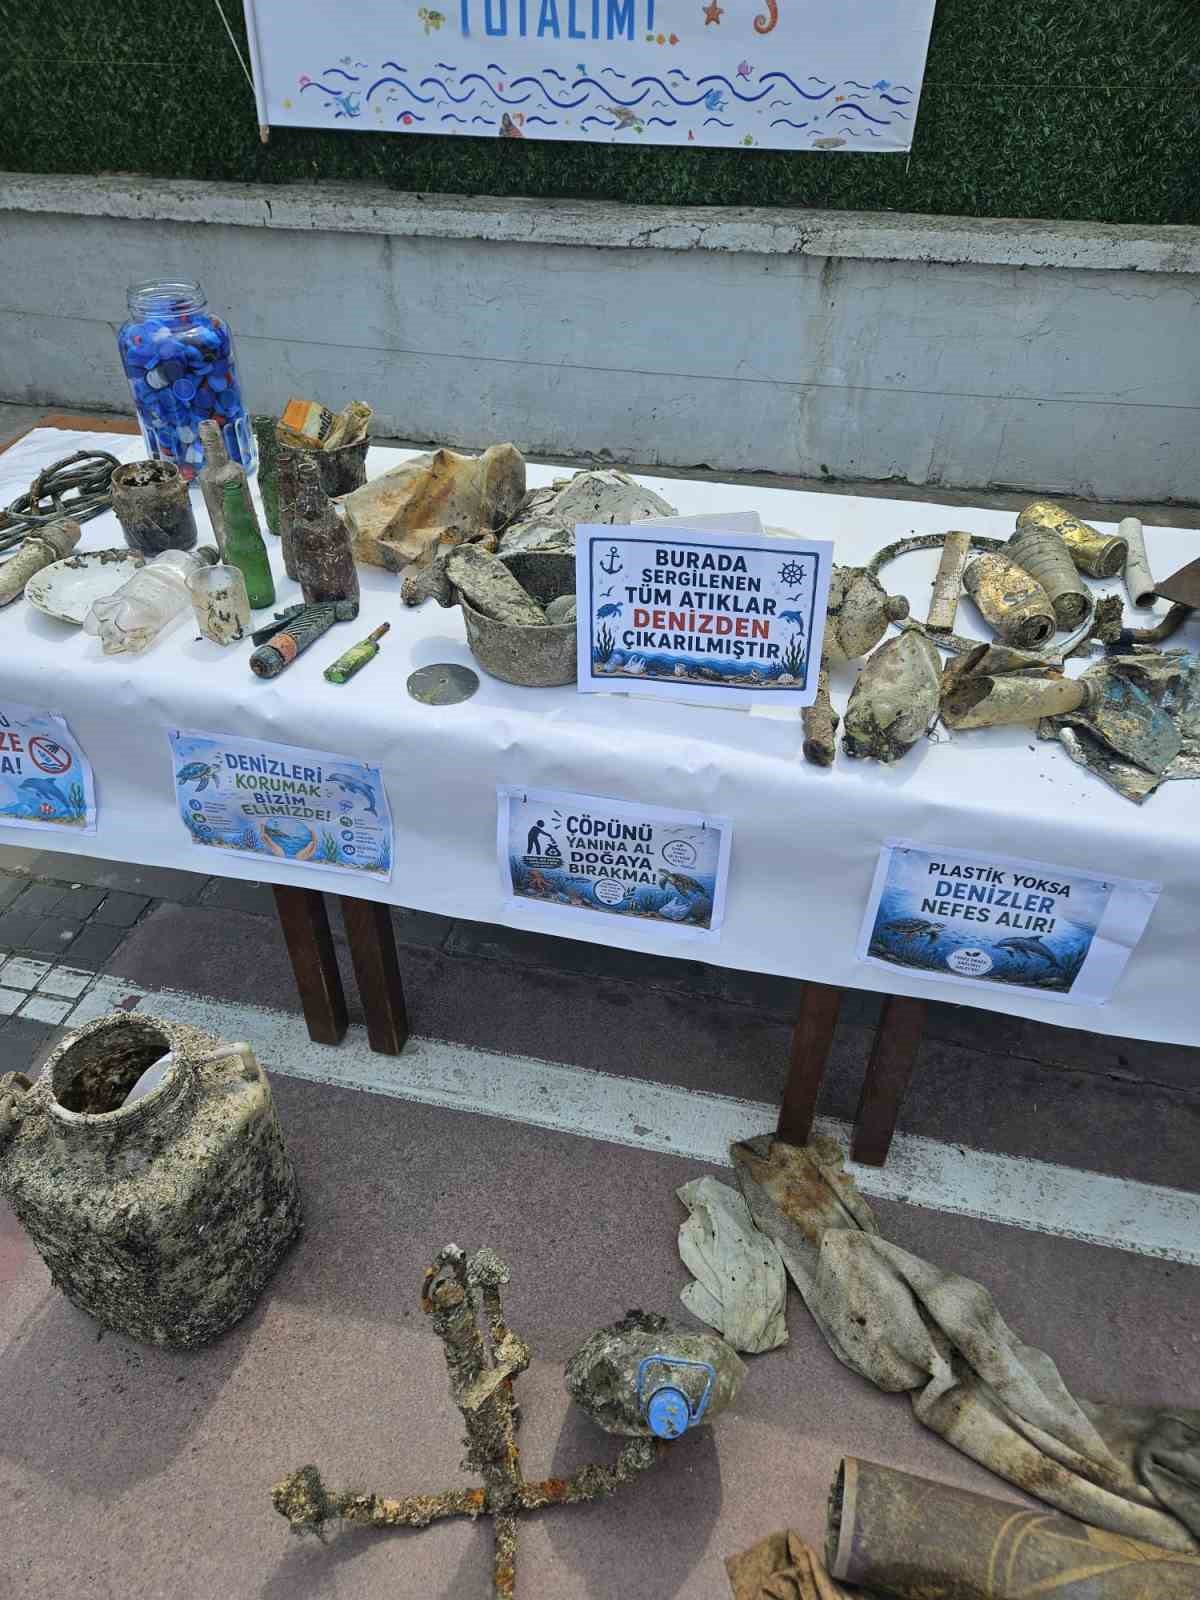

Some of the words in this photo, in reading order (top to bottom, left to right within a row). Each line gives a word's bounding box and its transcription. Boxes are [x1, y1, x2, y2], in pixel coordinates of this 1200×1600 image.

[656, 549, 747, 572] BURADA
[641, 567, 761, 592] SERGİLENEN
[625, 584, 671, 606] TÜM
[679, 591, 777, 615] ATIKLAR
[633, 608, 770, 639] DENİZDEN
[622, 630, 780, 659] ÇIKARILMIŞTIR
[225, 753, 322, 784] DENİZLERİ
[235, 773, 321, 798] KORUMAK
[253, 791, 306, 806] BİZİM
[241, 804, 331, 822] ELİMİZDE!
[566, 814, 653, 842] ÇÖPÜNÜ
[566, 836, 625, 852] YANINA
[633, 844, 655, 855] AL
[568, 863, 657, 884] BIRAKMA!
[571, 851, 652, 870] DOĞAYA
[928, 862, 1005, 884] PLASTİK
[1012, 874, 1071, 897] YOKSA
[935, 880, 1056, 914] DENİZLER
[920, 898, 991, 923] NEFES
[995, 911, 1056, 934] ALIR!
